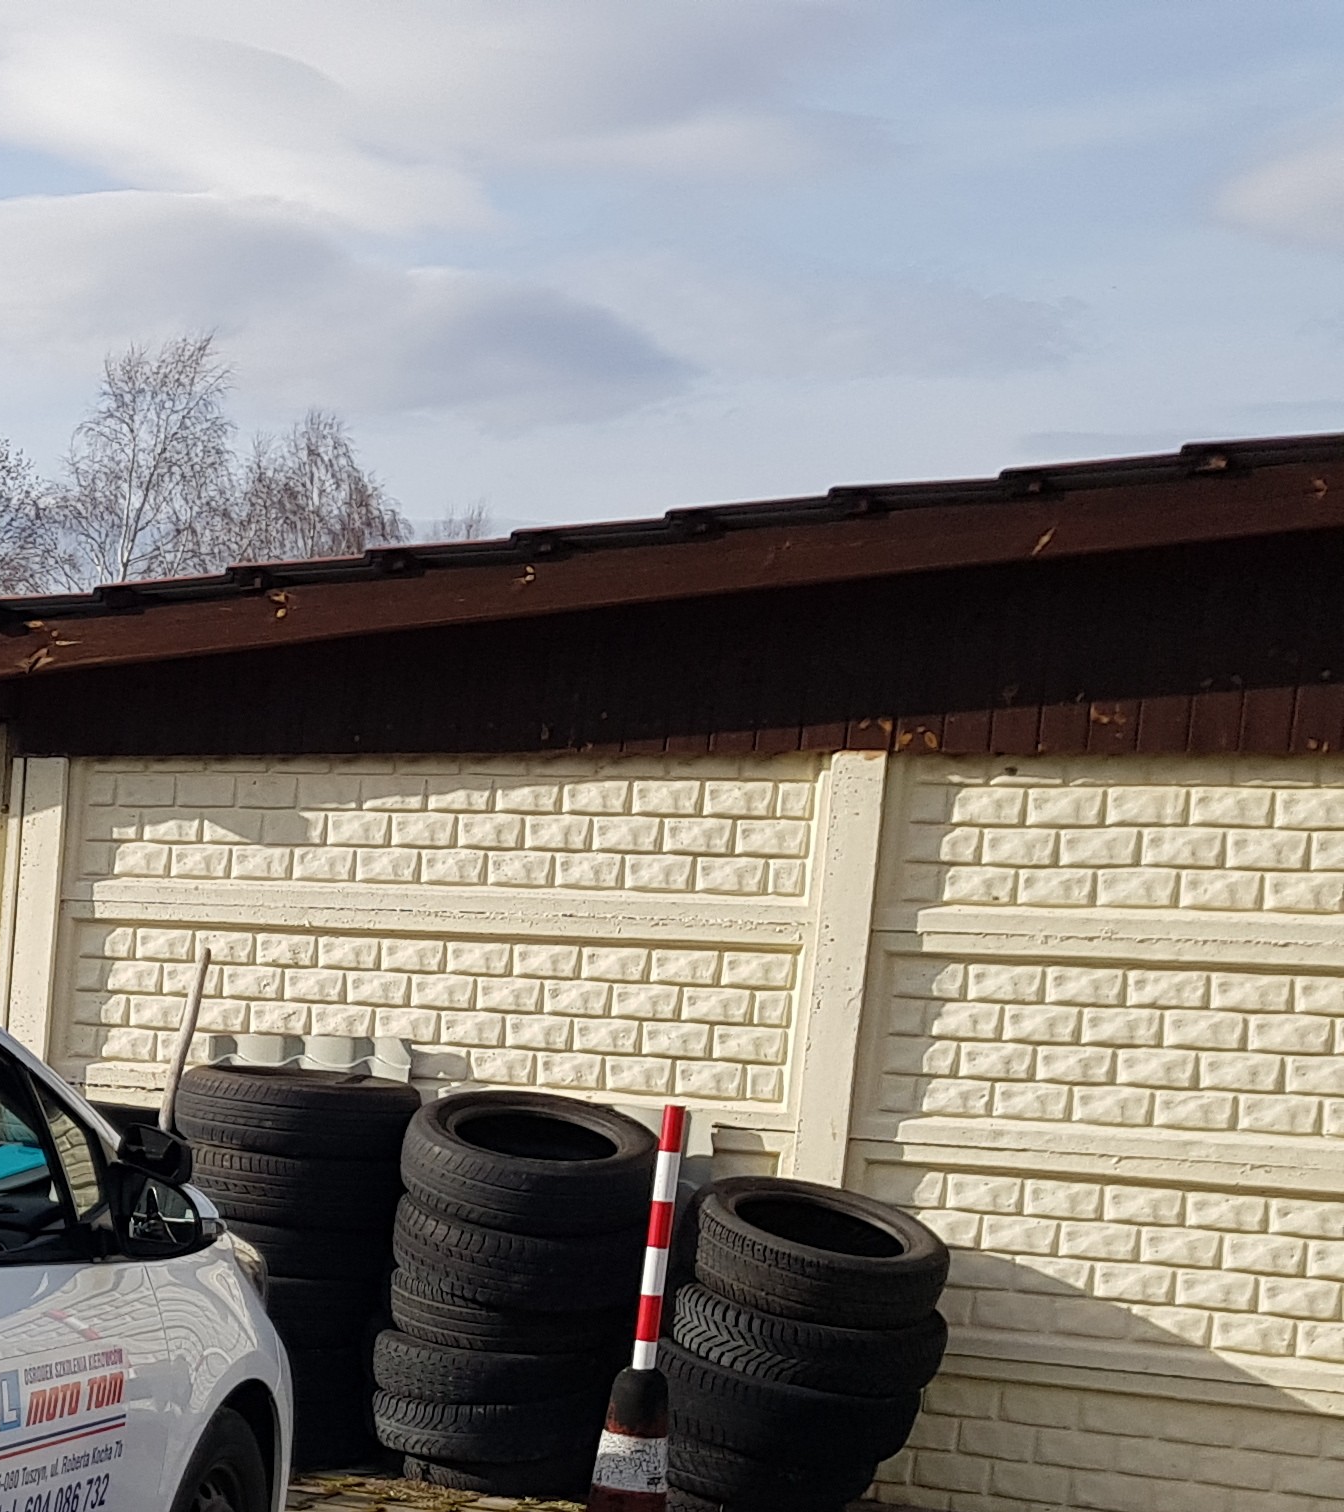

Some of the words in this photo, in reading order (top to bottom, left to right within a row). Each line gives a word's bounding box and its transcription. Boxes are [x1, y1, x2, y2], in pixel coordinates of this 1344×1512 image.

[0, 1379, 17, 1424] L
[25, 1381, 81, 1428] MOTO
[86, 1371, 124, 1411] TOM
[82, 1472, 110, 1512] 732
